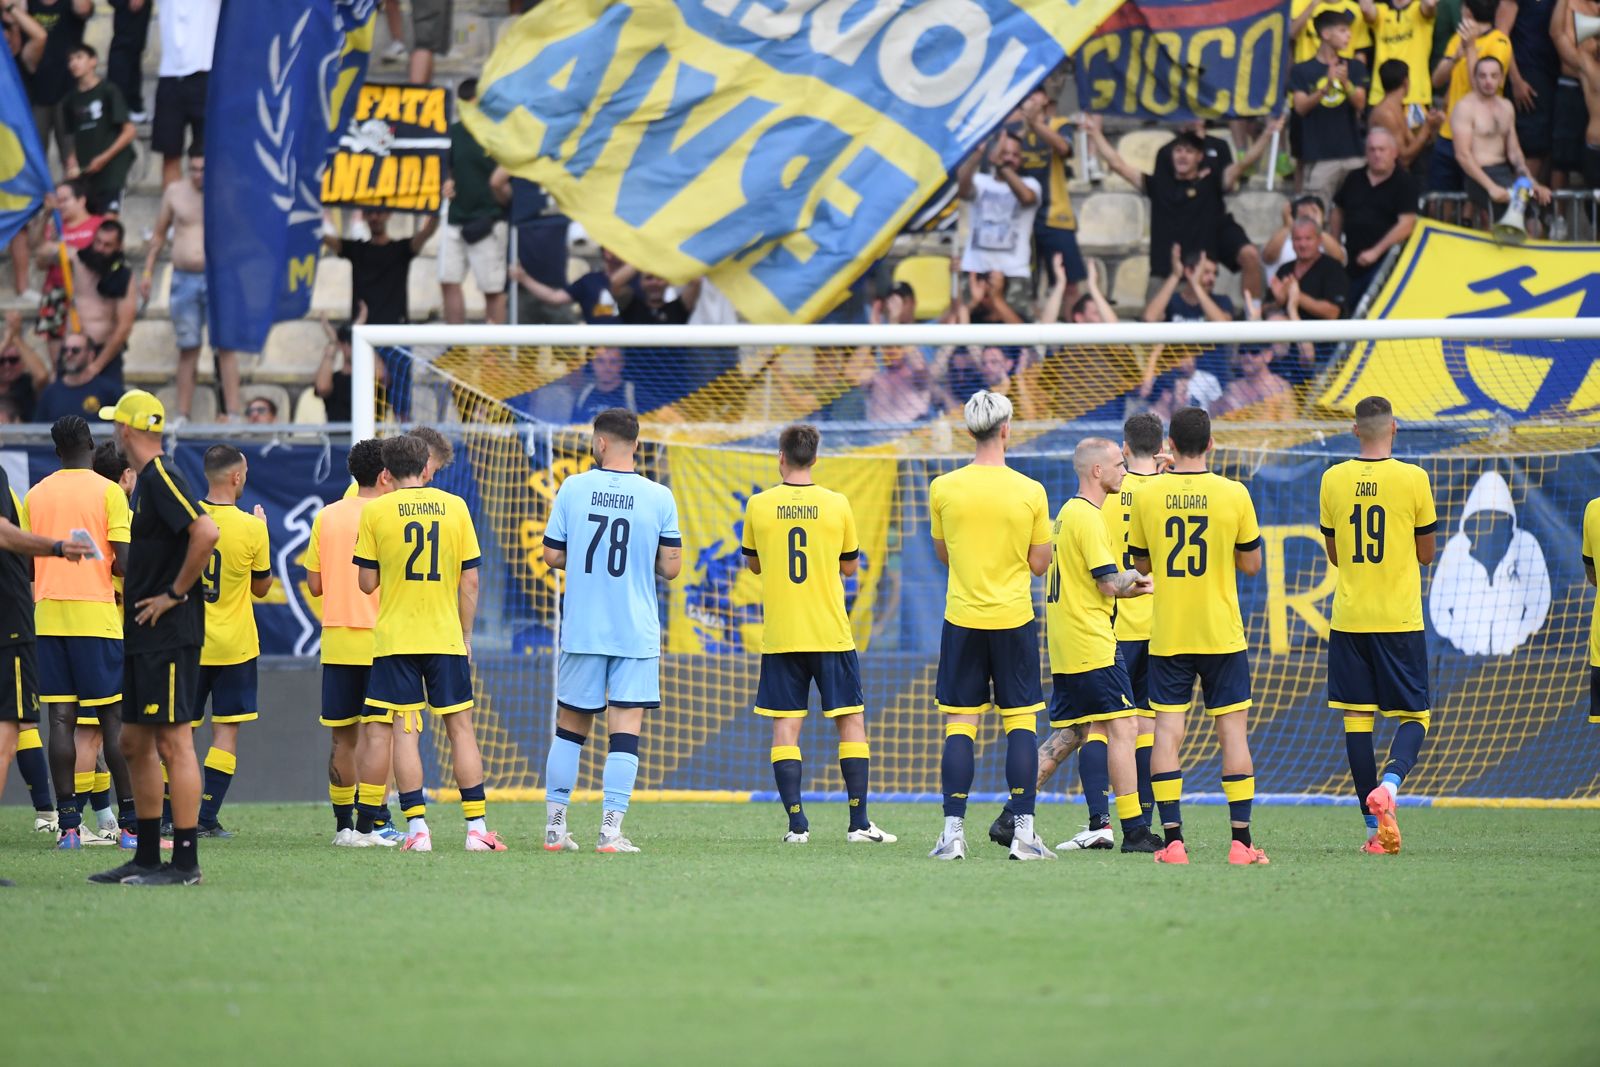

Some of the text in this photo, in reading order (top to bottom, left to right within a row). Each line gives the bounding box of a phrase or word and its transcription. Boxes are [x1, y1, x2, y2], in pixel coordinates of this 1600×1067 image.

[1082, 12, 1284, 119] GIOCO
[398, 502, 447, 517] BOZHANAJ
[591, 491, 635, 511] BAGHERIA
[776, 505, 819, 520] MAGNINO
[1166, 494, 1208, 510] CALDARA
[1355, 481, 1378, 497] ZARO
[404, 520, 442, 582] 21
[584, 513, 631, 578] 78
[787, 526, 808, 585] 6
[1165, 515, 1209, 578] 23
[1349, 504, 1386, 564] 19
